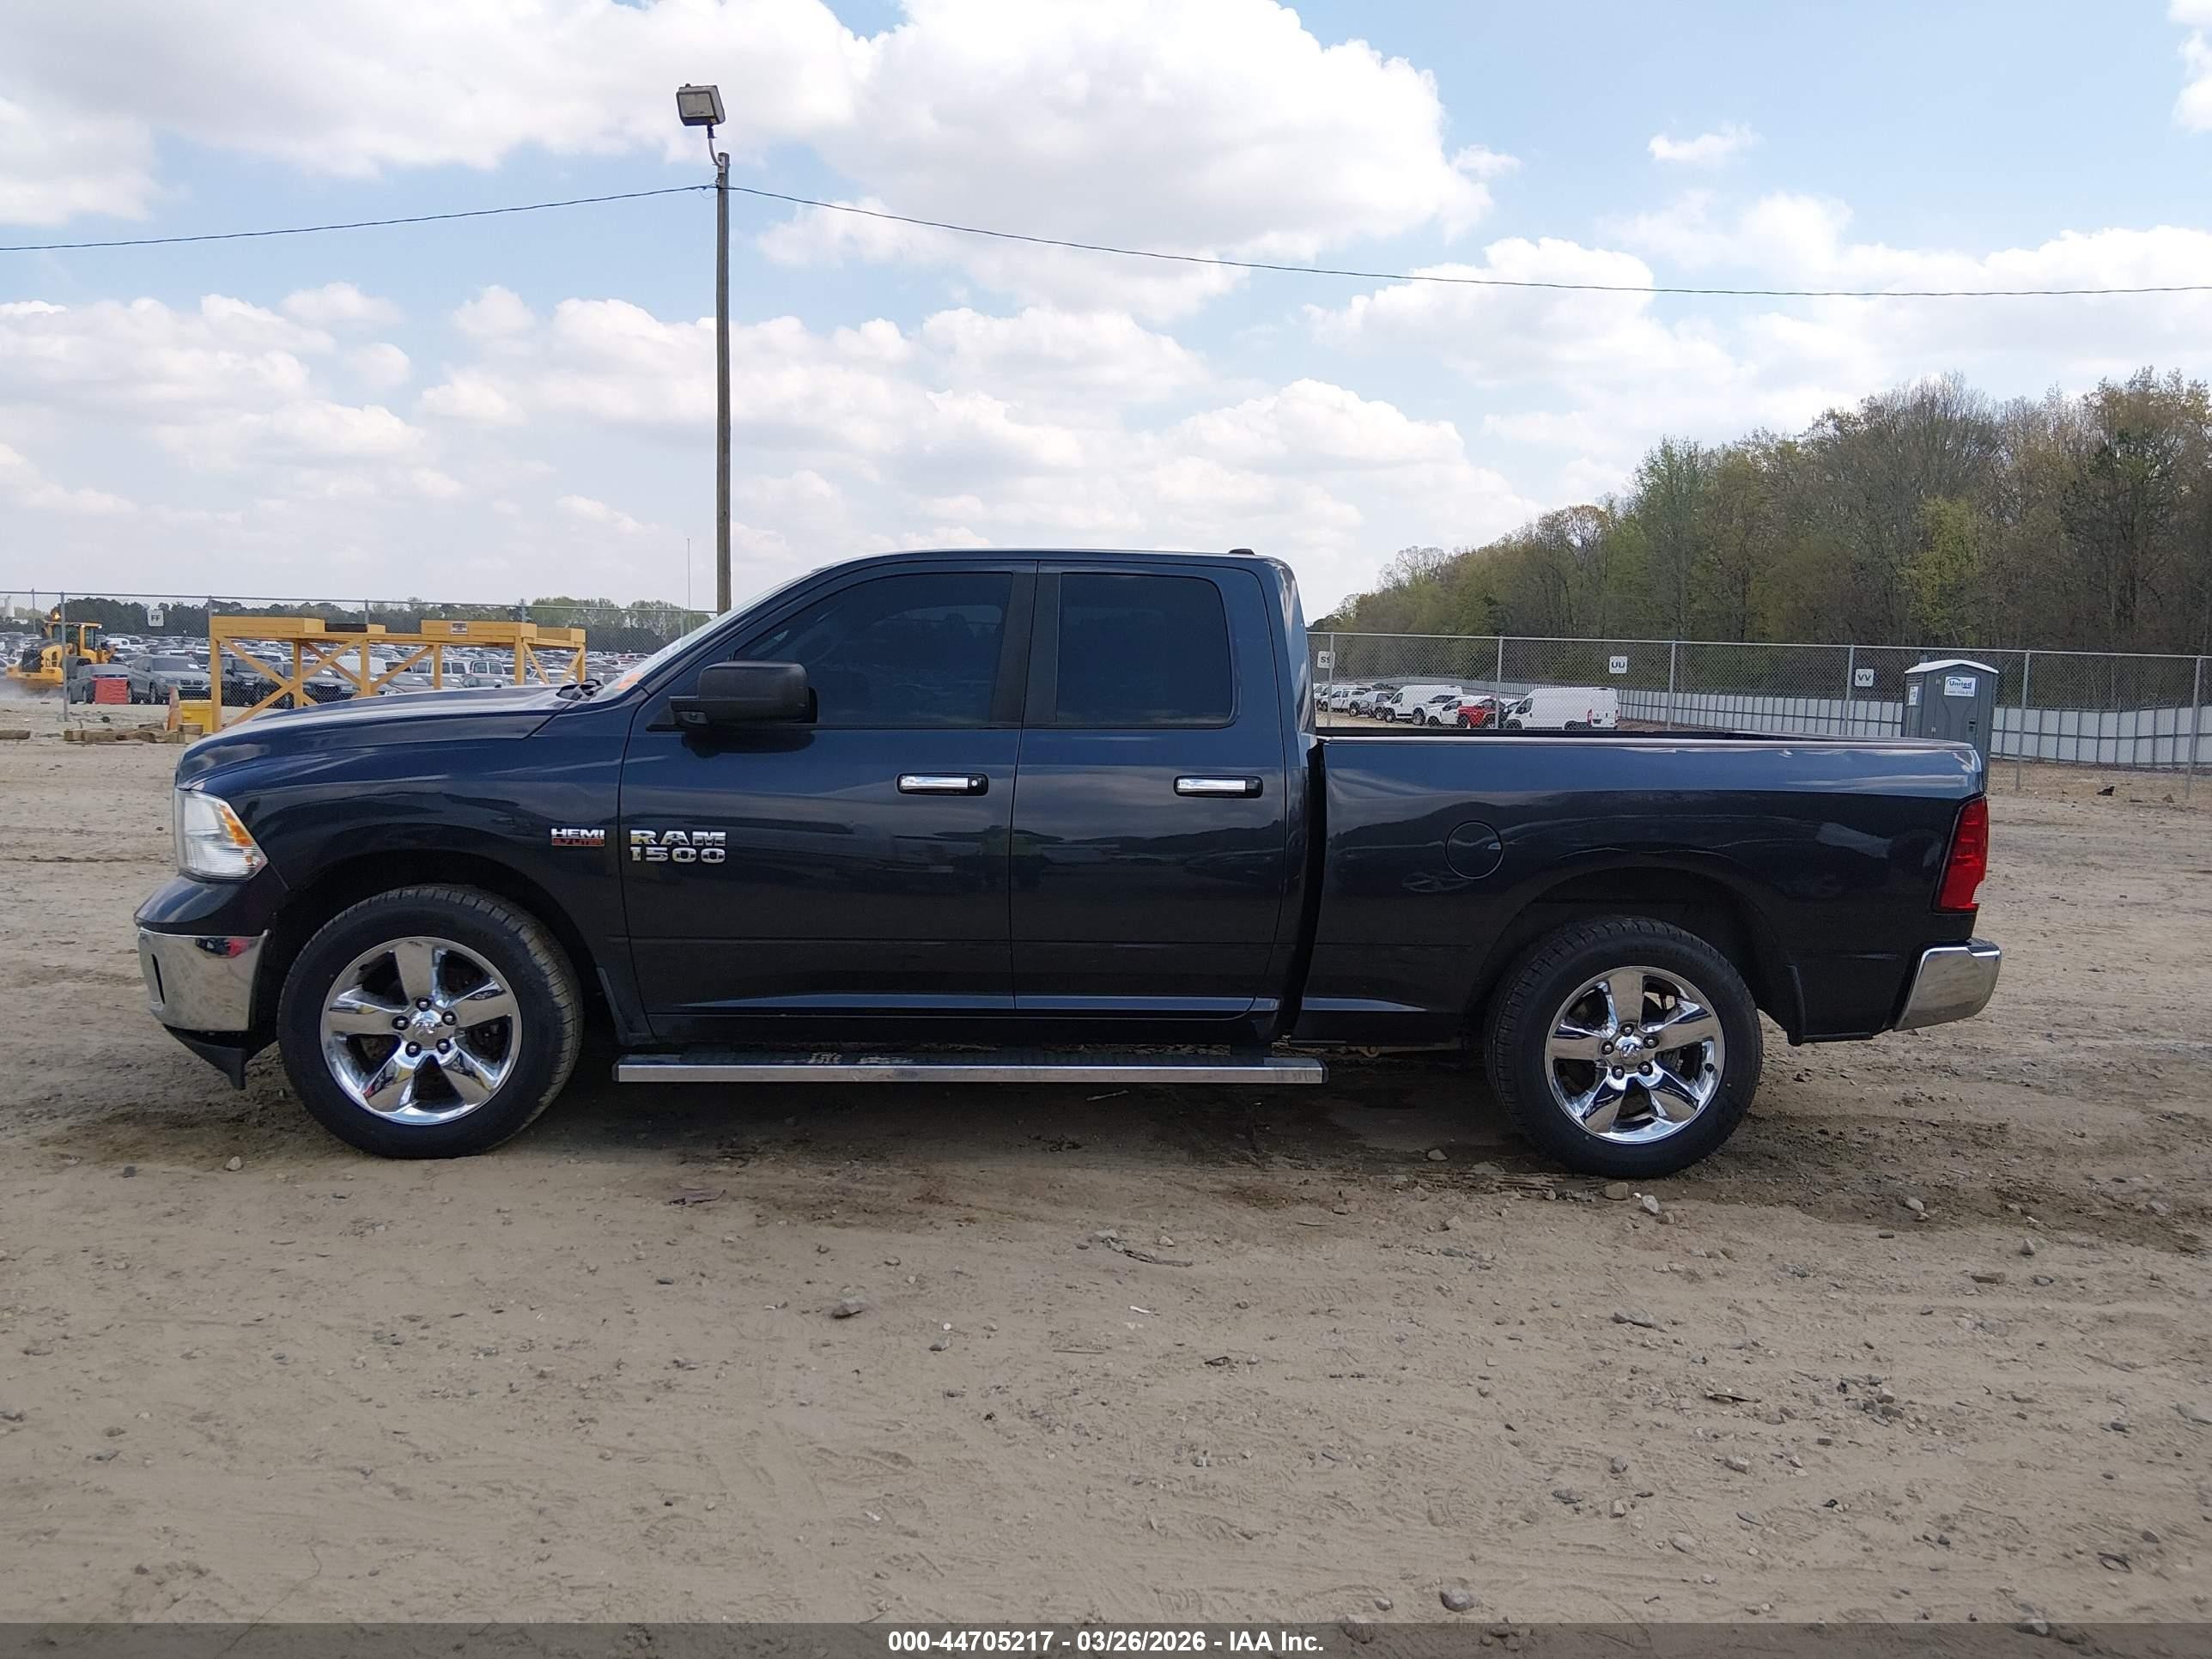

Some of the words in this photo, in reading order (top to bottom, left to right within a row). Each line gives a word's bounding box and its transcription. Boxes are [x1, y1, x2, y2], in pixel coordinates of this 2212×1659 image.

[550, 828, 605, 838] HEMI
[629, 830, 726, 846] RAM
[629, 847, 726, 864] 1500
